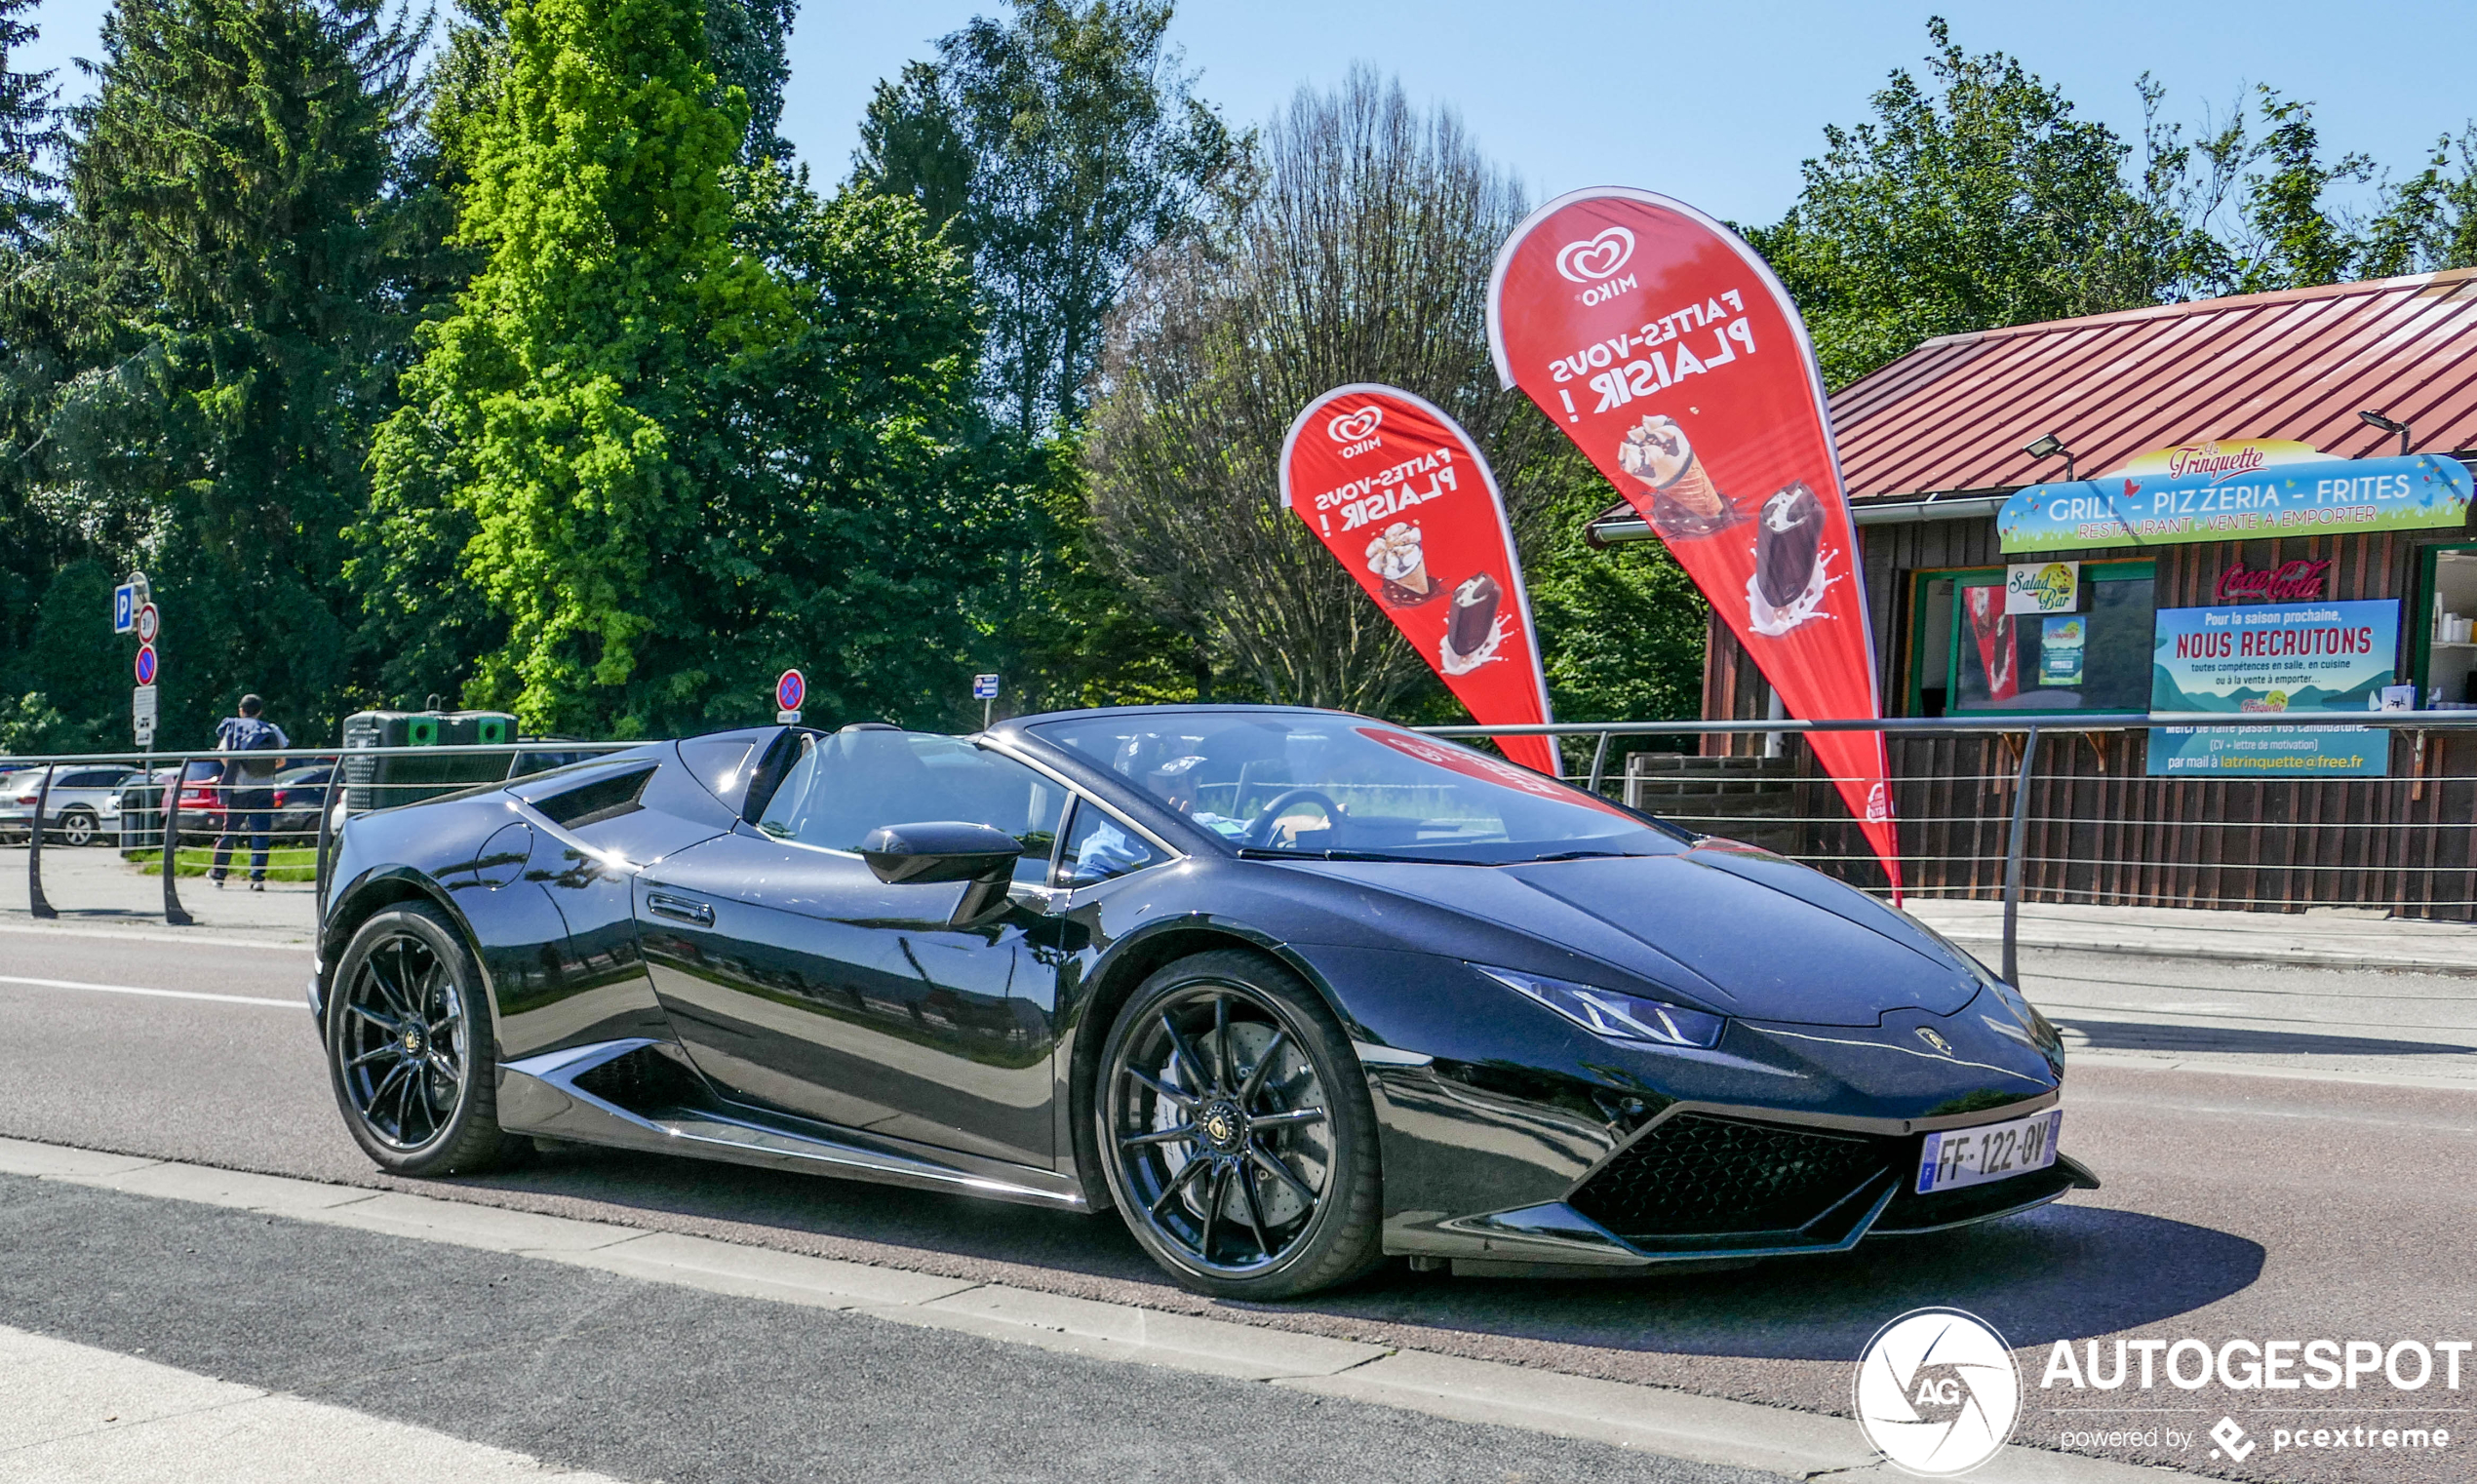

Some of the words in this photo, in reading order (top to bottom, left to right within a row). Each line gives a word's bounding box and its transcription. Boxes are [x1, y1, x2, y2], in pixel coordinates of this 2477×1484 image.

[2169, 447, 2264, 480] Trinquette
[2049, 495, 2119, 521] GRILL
[2153, 485, 2280, 515] PIZZERIA
[2316, 474, 2411, 504] FRITES
[2078, 517, 2192, 539] RESTAURANT
[2207, 513, 2257, 531] VENTE
[2262, 511, 2275, 528] A
[2282, 505, 2377, 527] EMPORTER
[2009, 571, 2051, 594] Salad
[119, 594, 129, 623] P
[2039, 587, 2070, 610] Bar
[2205, 612, 2230, 626] Pour
[2231, 611, 2241, 624] la
[2245, 610, 2280, 624] saison
[2283, 607, 2342, 626] prochaine,
[2176, 631, 2233, 659] NOUS
[2240, 626, 2372, 657] RECRUTONS
[2191, 663, 2216, 672] toutes
[2218, 661, 2270, 673] compétences
[2272, 661, 2281, 670] en
[2284, 659, 2306, 671] salle,
[2308, 660, 2318, 669] en
[2320, 659, 2351, 669] cuisine
[2216, 677, 2225, 685] ou
[2234, 675, 2241, 684] la
[2243, 675, 2265, 684] vente
[2275, 674, 2321, 685] emporter...
[2233, 740, 2256, 750] lettre
[2258, 740, 2268, 750] de
[2168, 757, 2183, 770] par
[2186, 755, 2209, 767] mail
[2211, 754, 2219, 768] à
[2221, 754, 2364, 770] latrinquette@free.fr
